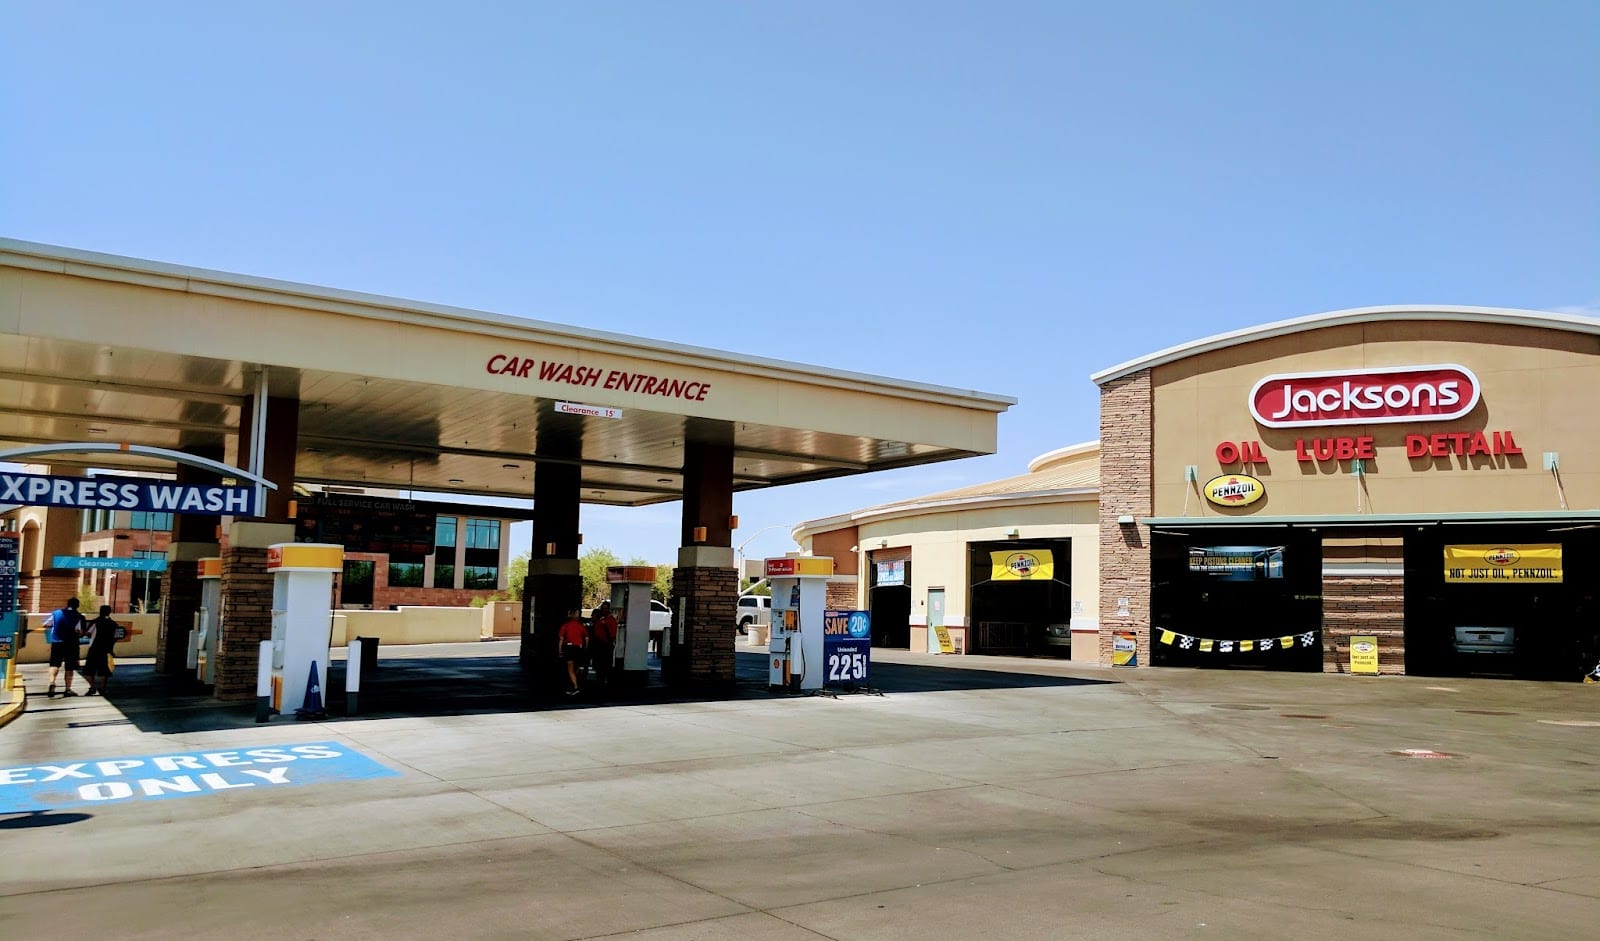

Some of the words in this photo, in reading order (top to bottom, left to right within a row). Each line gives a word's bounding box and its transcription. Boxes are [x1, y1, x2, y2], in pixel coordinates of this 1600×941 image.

[486, 354, 535, 378] CAR
[539, 360, 603, 387] WASH
[603, 370, 711, 401] ENTRANCE
[1272, 380, 1460, 419] Jacksons
[561, 404, 600, 416] Clearance
[1215, 440, 1268, 464] OIL
[1295, 435, 1375, 462] LUBE
[1405, 430, 1523, 458] DETAIL
[149, 484, 249, 513] WASH
[1211, 482, 1256, 498] PENNZOIL
[317, 497, 338, 506] FULL
[338, 498, 373, 509] SERVICE
[374, 502, 391, 510] CAR
[392, 502, 416, 512] WASH
[79, 560, 120, 568] Clearance
[1189, 556, 1203, 566] KEEP
[1203, 556, 1228, 566] PISTONS
[1488, 552, 1515, 561] PENNZOIL
[1449, 568, 1465, 579] NOT
[1468, 568, 1489, 579] JUST
[1492, 568, 1510, 580] OIL,
[825, 617, 849, 635] SAVE
[0, 744, 343, 785] EXPRESS
[78, 766, 292, 801] ONLY
